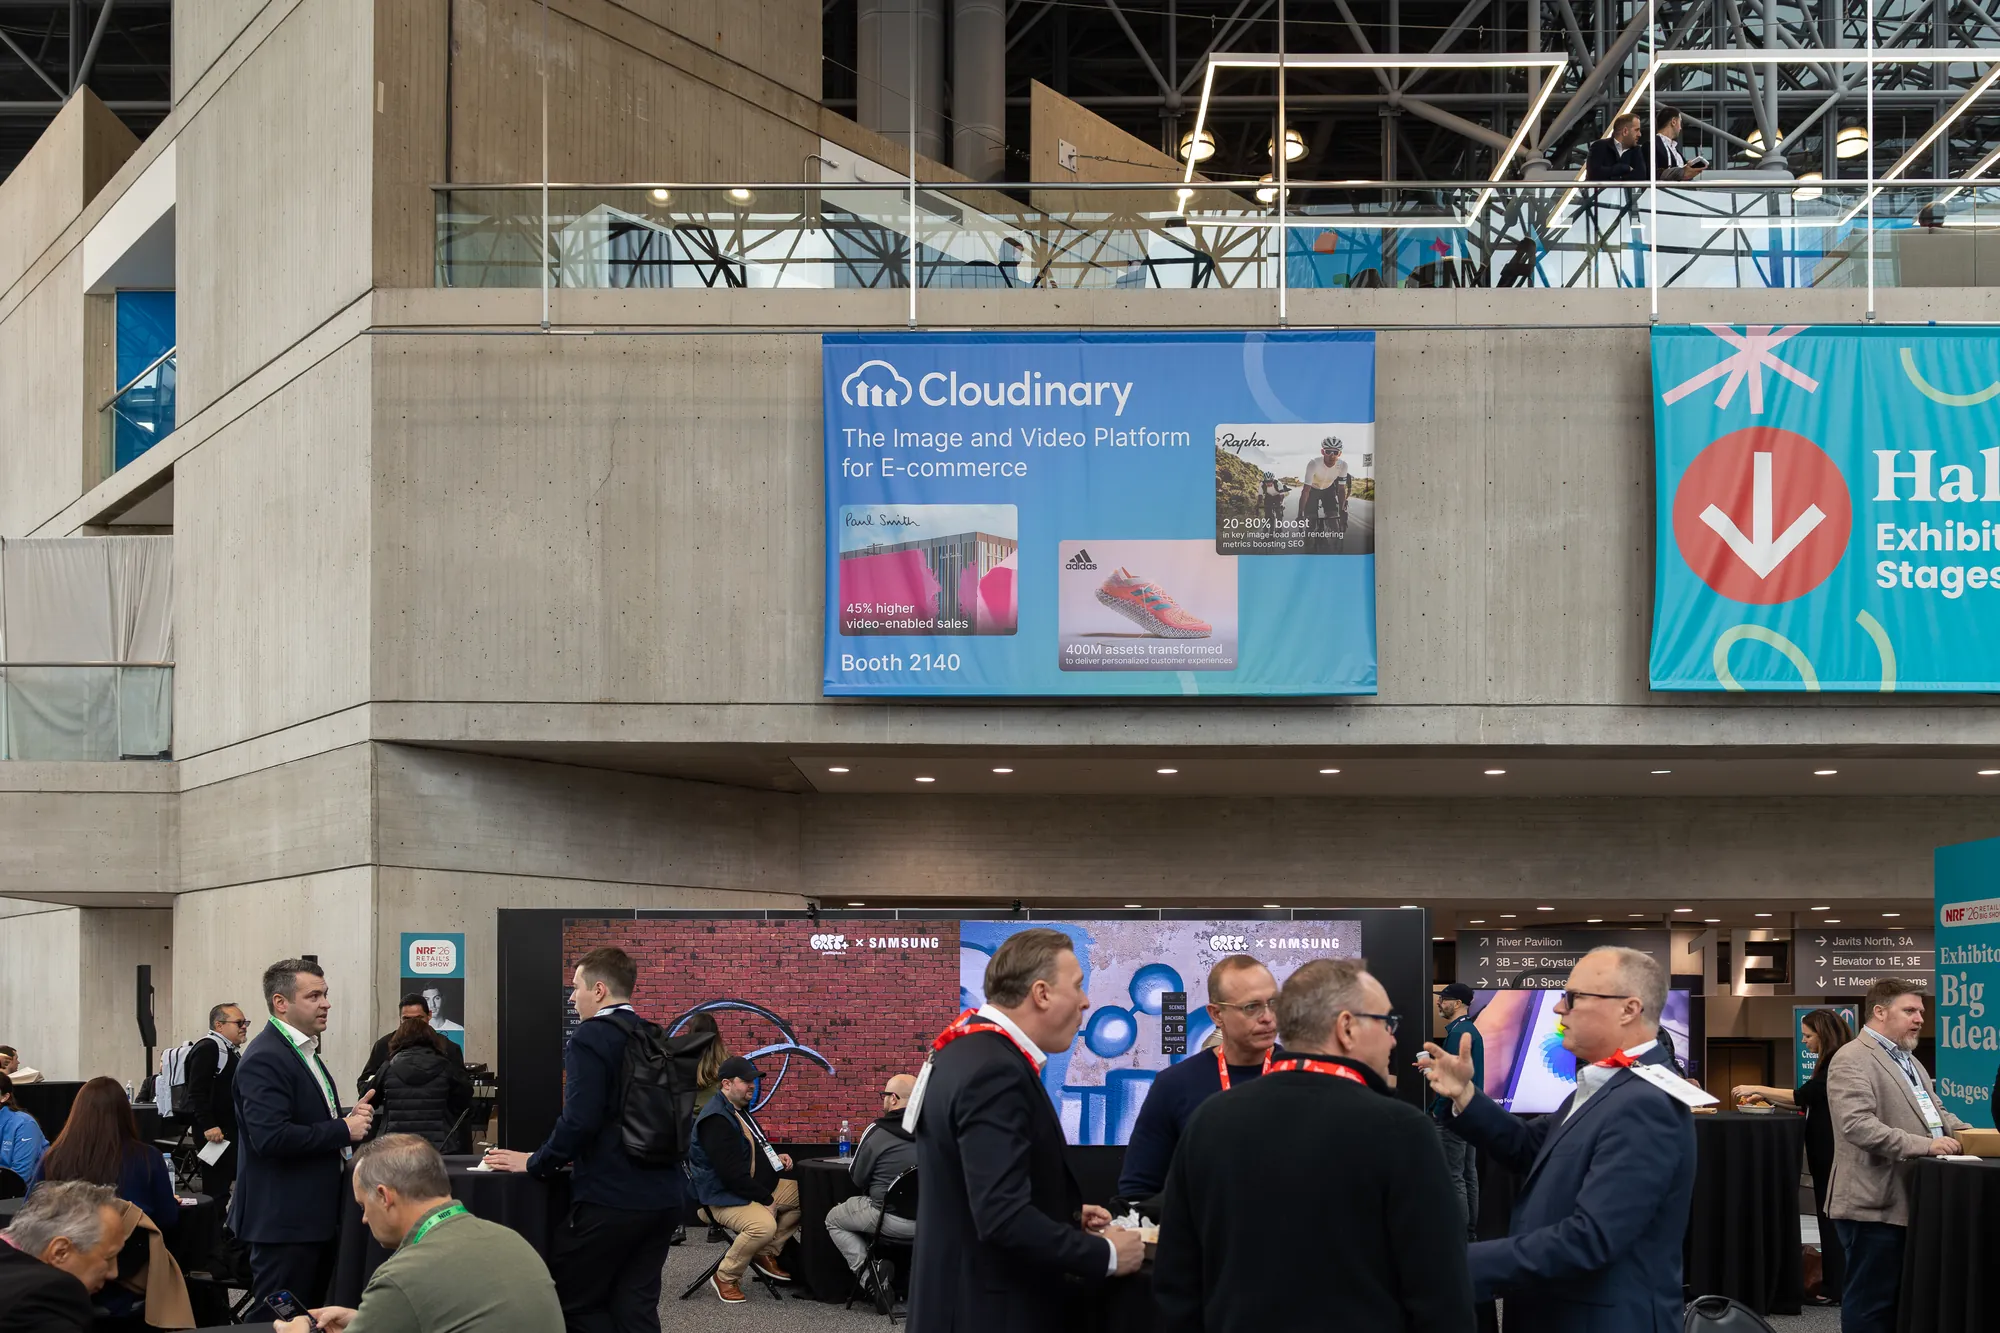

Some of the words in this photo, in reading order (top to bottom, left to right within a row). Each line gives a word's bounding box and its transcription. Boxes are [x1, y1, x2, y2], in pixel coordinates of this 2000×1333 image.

[919, 371, 1133, 416] Cloudinary
[842, 428, 885, 447] The
[894, 428, 963, 453] Image
[971, 428, 1012, 447] and
[1021, 427, 1086, 447] Video
[1095, 427, 1190, 447] Platform
[842, 457, 873, 477] for
[882, 457, 1028, 477] E-commerce
[1872, 446, 2000, 502] Hal
[846, 512, 874, 527] Paul
[879, 514, 921, 527] Smith
[1223, 518, 1271, 529] 20-80%
[1275, 518, 1310, 529] boost
[1231, 530, 1244, 541] key
[1247, 530, 1289, 541] image-load
[1291, 530, 1306, 538] and
[1307, 530, 1344, 541] rendering
[1222, 540, 1251, 549] metrics
[1253, 540, 1286, 550] boosting
[1287, 540, 1305, 548] SEO
[1065, 562, 1097, 571] adidas
[846, 603, 873, 614] 45%
[876, 603, 915, 616] higher
[846, 618, 934, 629] video-enabled
[937, 618, 969, 629] sales
[1066, 644, 1102, 655] 400M
[1105, 645, 1145, 655] assets
[1148, 644, 1223, 655] transformed
[841, 654, 902, 672] Booth
[909, 653, 961, 671] 2140
[1075, 657, 1100, 665] deliver
[1102, 657, 1149, 666] personalized
[1151, 657, 1184, 665] customer
[1187, 657, 1233, 666] experiences
[1945, 908, 1965, 922] NRF
[1979, 912, 1988, 920] BIG
[869, 937, 939, 948] SAMSUNG
[1269, 938, 1340, 949] SAMSUNG
[1496, 938, 1522, 947] River
[1525, 938, 1562, 947] Pavilion
[1832, 937, 1862, 946] Javits
[1865, 937, 1895, 947] North,
[1899, 937, 1914, 946] 3A
[416, 946, 436, 955] NRF
[1940, 943, 2000, 965] Exhibito
[1496, 958, 1510, 967] 3B
[1522, 958, 1537, 968] 3E,
[1540, 957, 1576, 969] Crystal
[1833, 957, 1873, 966] Elevator
[1876, 957, 1886, 966] to
[1889, 957, 1904, 967] 1E,
[1907, 957, 1921, 966] 3E
[1497, 978, 1510, 987] 1A
[1522, 978, 1537, 988] 1D,
[1540, 977, 1569, 988] Spec
[1833, 977, 1846, 986] 1E
[1849, 977, 1879, 986] Meeti
[1941, 971, 1985, 1018] Big
[1941, 1014, 2000, 1051] Idea
[1941, 1077, 1989, 1105] Stages
